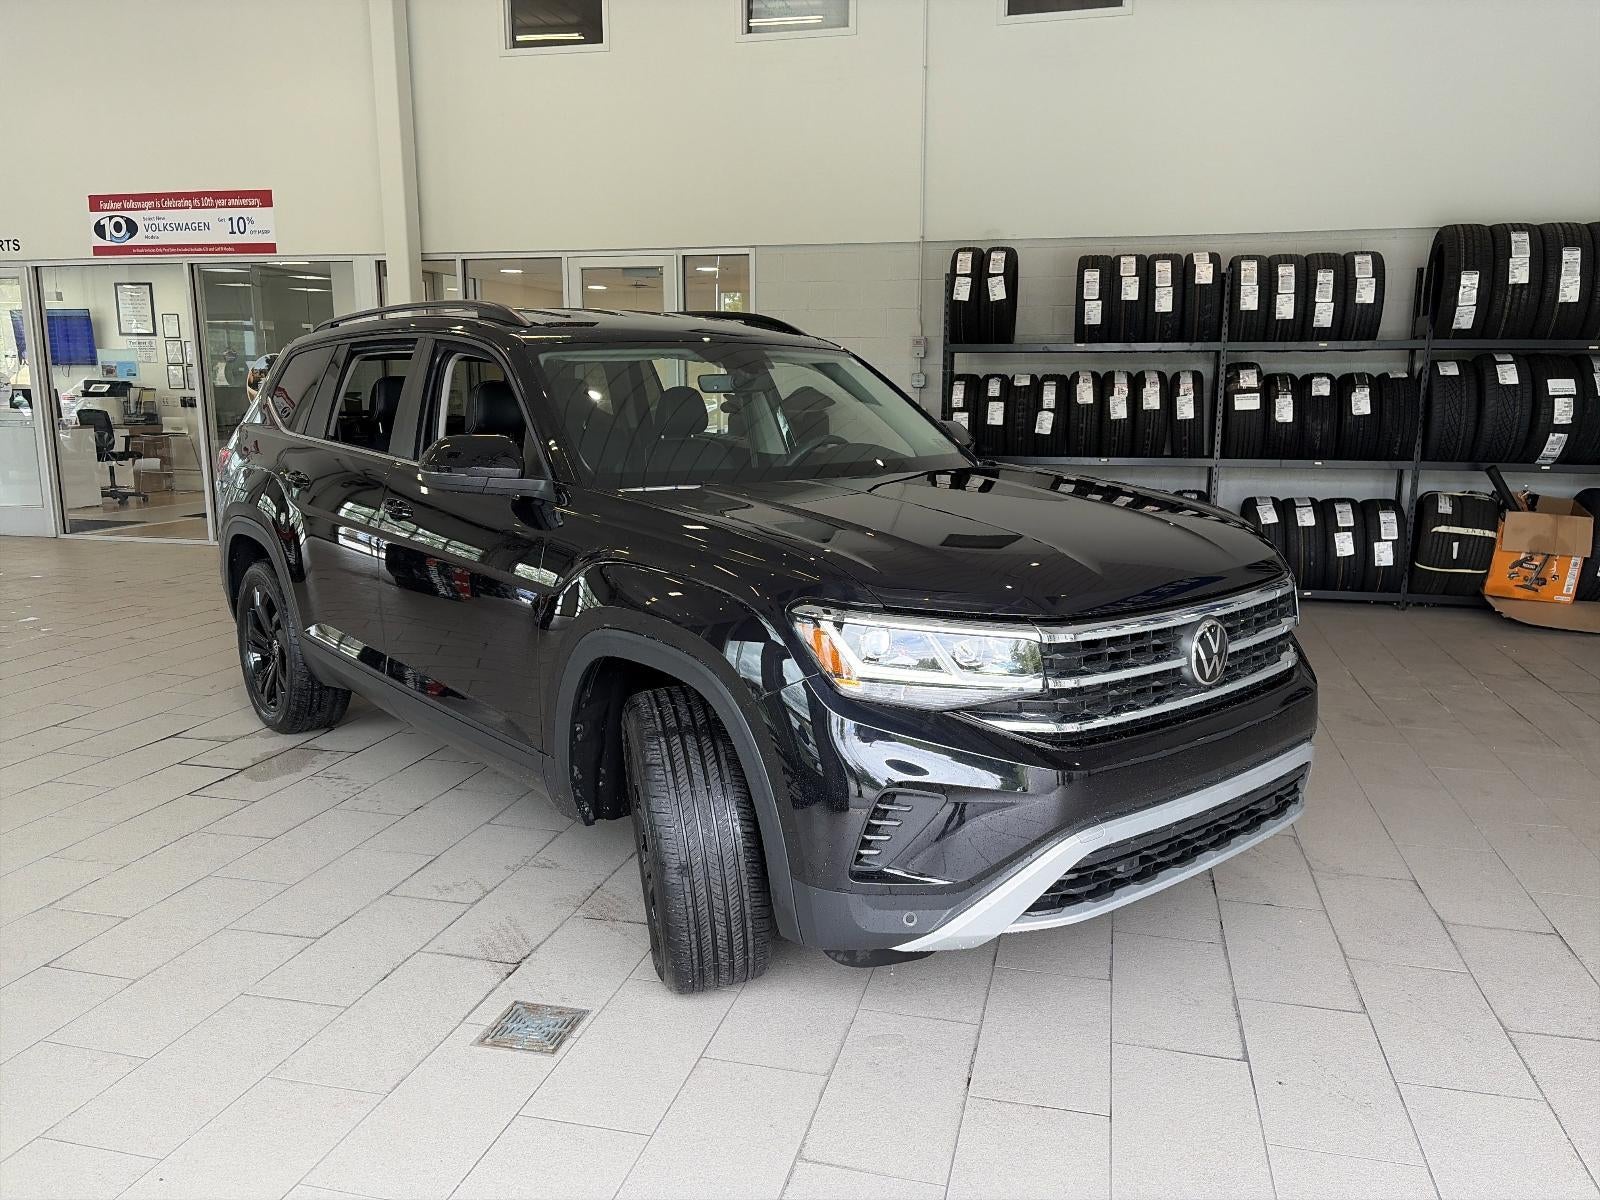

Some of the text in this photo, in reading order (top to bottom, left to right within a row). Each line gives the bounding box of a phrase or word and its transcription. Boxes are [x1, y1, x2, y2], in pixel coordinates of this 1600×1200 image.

[99, 200, 122, 210] Faulkner
[122, 199, 155, 211] Volkswagen
[155, 198, 161, 208] is
[161, 197, 192, 209] Celebrating
[201, 196, 214, 207] 10th
[214, 198, 227, 208] year
[100, 216, 127, 241] 10
[143, 221, 211, 233] VOLKSWAGEN
[1193, 621, 1227, 682] VW
